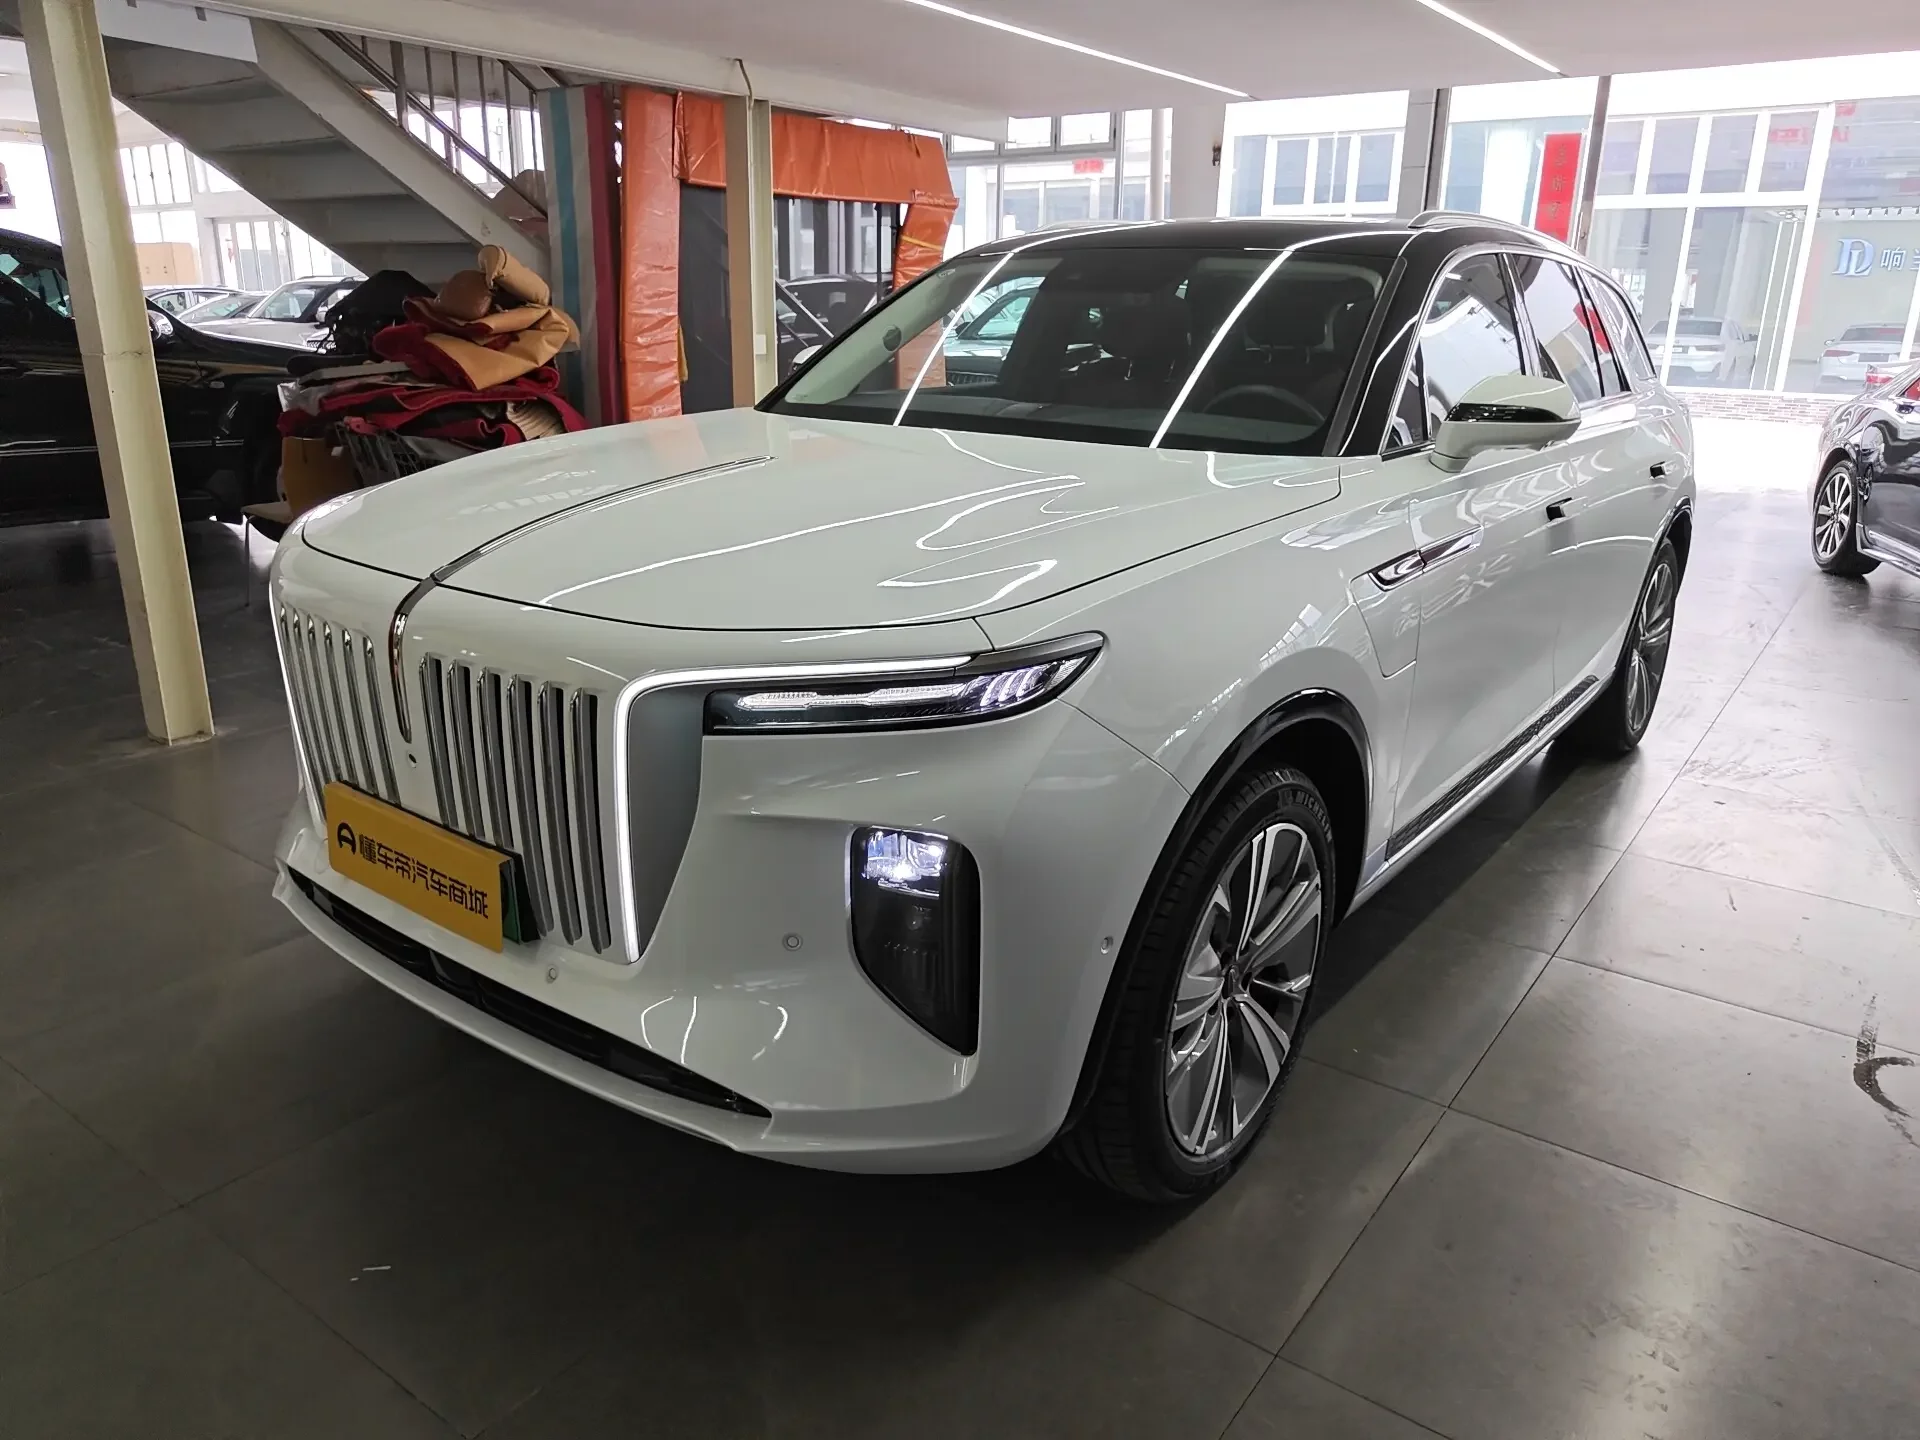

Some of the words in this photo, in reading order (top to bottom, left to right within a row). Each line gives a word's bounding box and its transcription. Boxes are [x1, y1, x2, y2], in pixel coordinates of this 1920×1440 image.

[1296, 791, 1333, 842] MICHELIN
[358, 833, 489, 919] 懂车帝汽车商城
